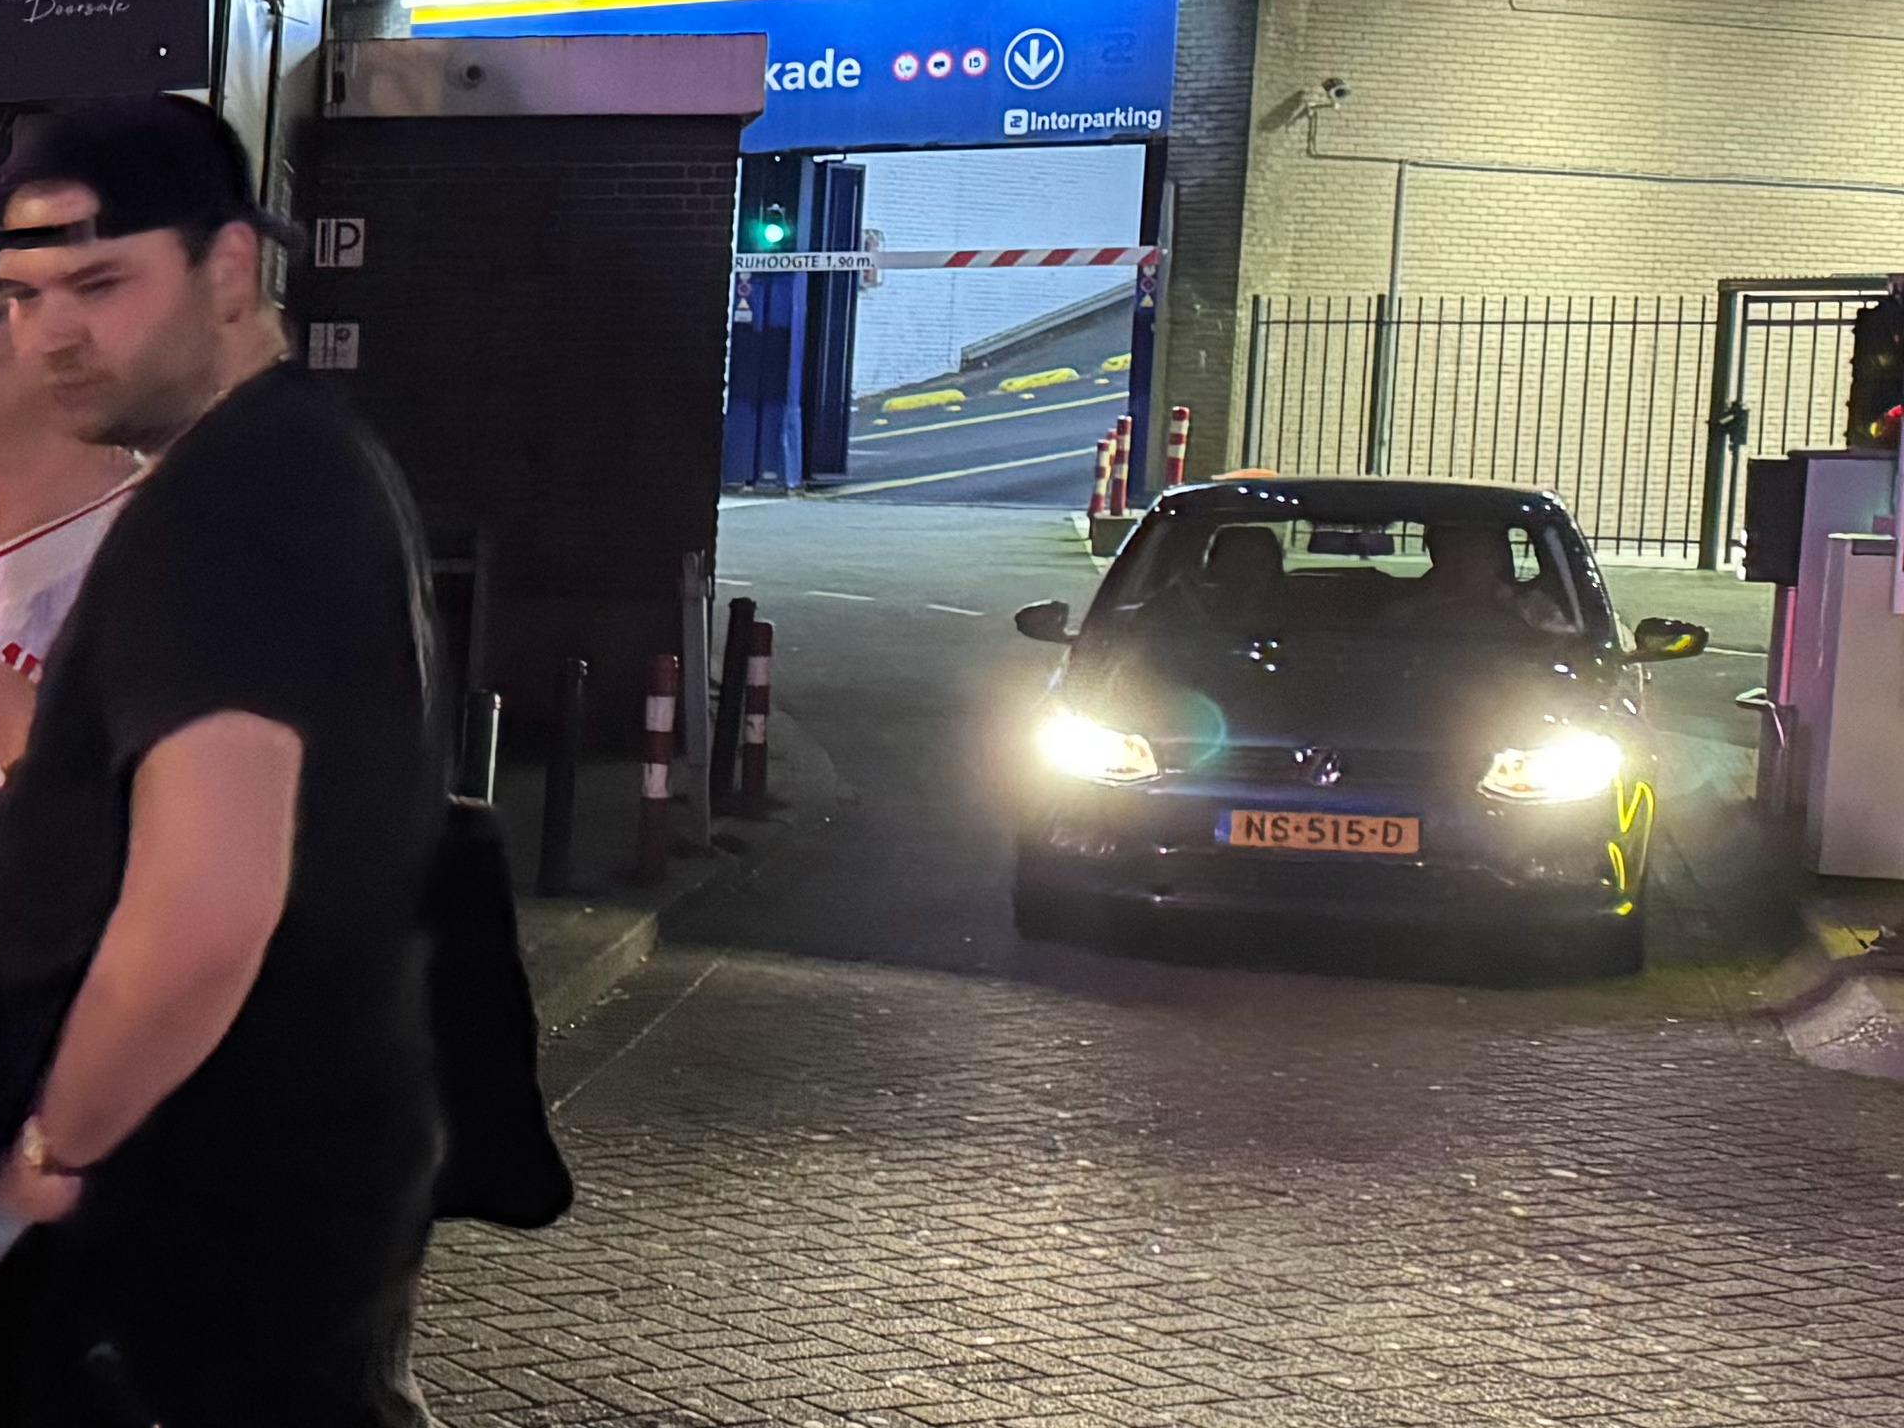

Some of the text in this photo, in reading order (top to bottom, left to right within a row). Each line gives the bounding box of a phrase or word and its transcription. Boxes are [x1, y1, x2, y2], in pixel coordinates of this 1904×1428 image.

[1030, 106, 1162, 133] Interparking
[826, 255, 855, 269] 1.90
[1245, 814, 1403, 848] NS-515-D
